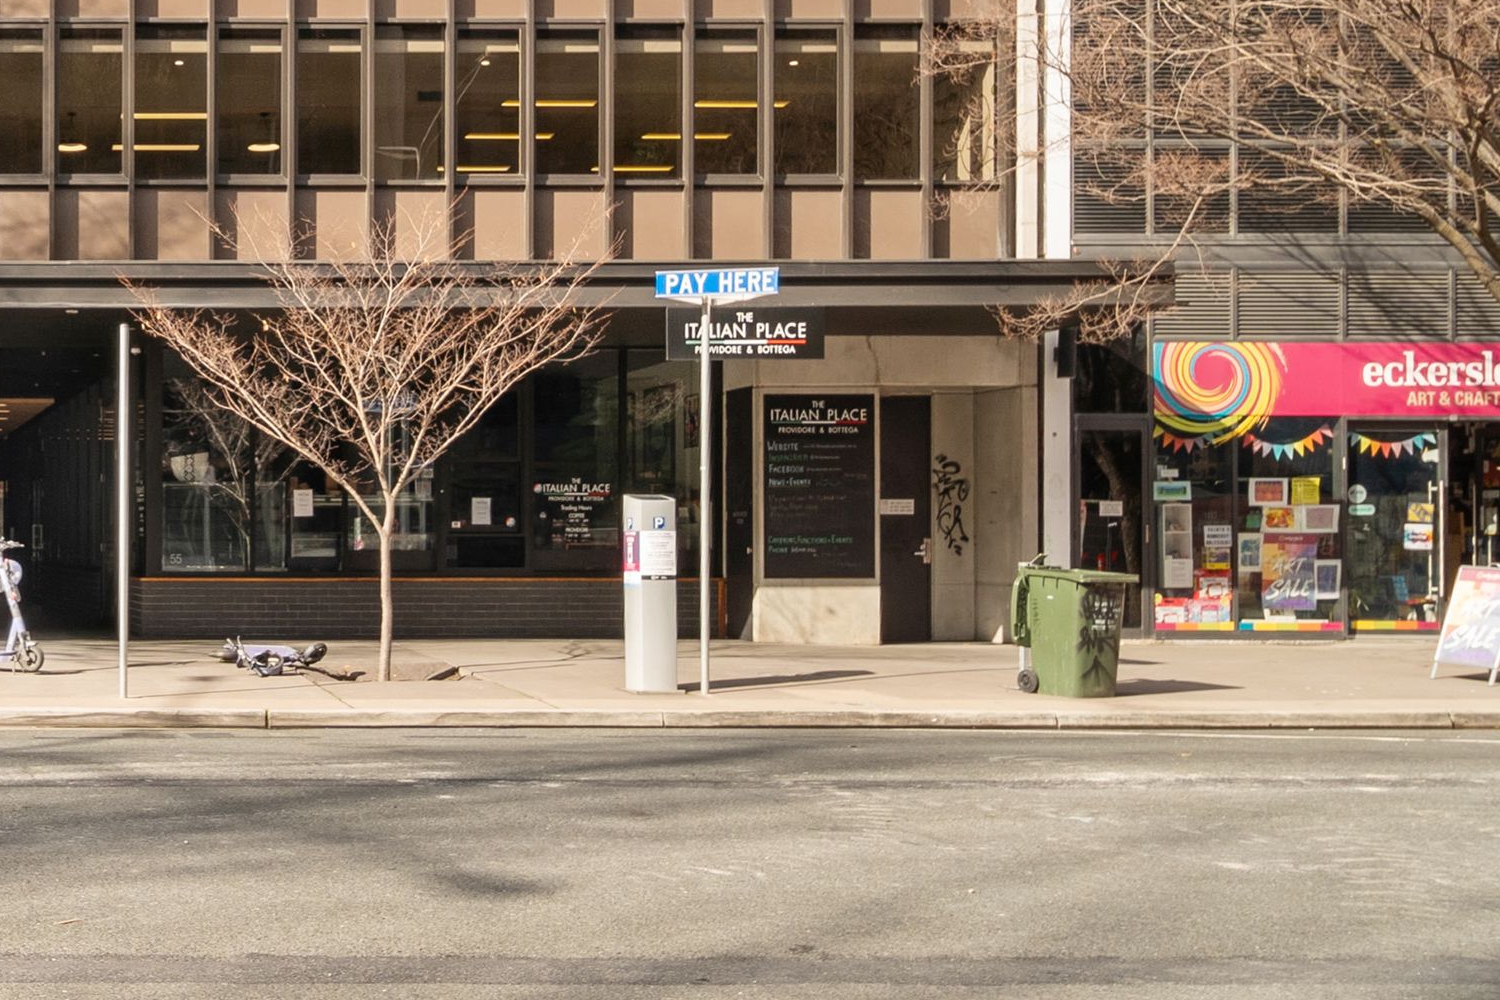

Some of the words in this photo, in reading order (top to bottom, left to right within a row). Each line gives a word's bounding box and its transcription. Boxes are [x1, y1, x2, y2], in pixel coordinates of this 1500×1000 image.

[666, 273, 706, 294] PAY
[719, 271, 775, 292] HERE
[736, 312, 753, 322] THE
[756, 322, 806, 338] PLACE
[694, 345, 742, 354] PVIDORE
[746, 345, 753, 354] &
[757, 345, 796, 354] BOTTEGA
[812, 400, 825, 409] THE
[1406, 391, 1436, 406] ART
[1438, 391, 1450, 405] &
[770, 408, 820, 421] ITALIAN
[827, 408, 867, 421] PLACE
[778, 426, 816, 434] PROVIDORE
[828, 426, 859, 434] BOTTEGA
[542, 483, 577, 492] ITALIAN
[582, 483, 611, 492] PLACE
[654, 517, 664, 529] P
[170, 553, 182, 564] 55
[1272, 557, 1307, 576] ART
[1265, 578, 1313, 600] SALE
